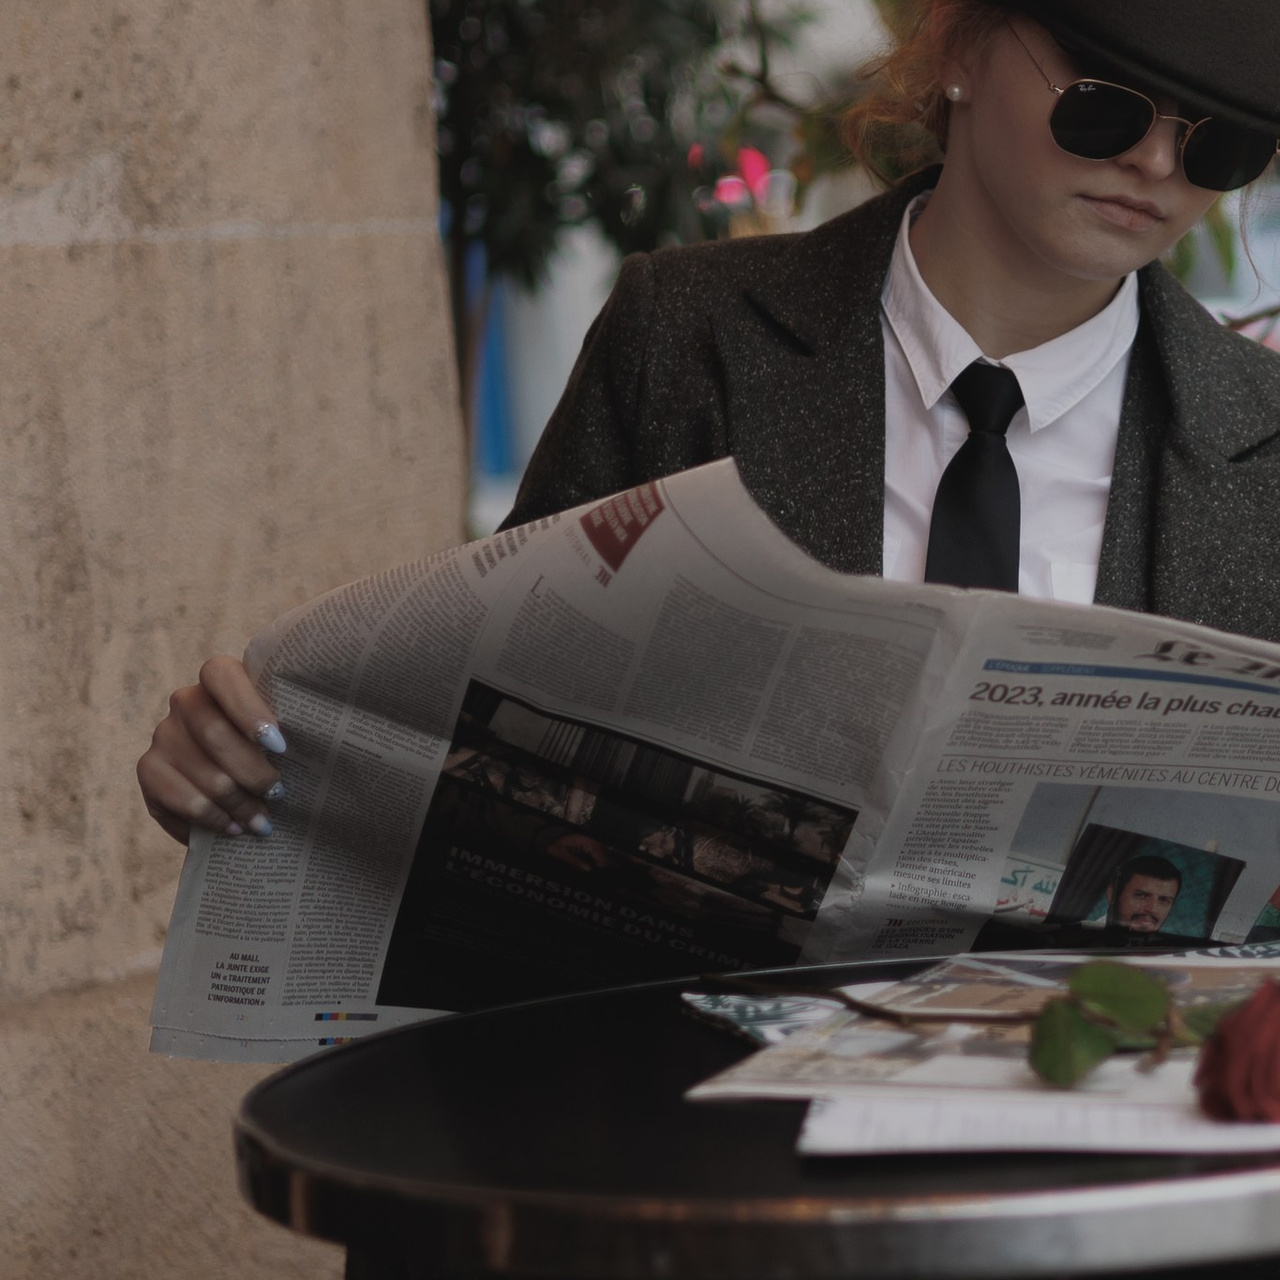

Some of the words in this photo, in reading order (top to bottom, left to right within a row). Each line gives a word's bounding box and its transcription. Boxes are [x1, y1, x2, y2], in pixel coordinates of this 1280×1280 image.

[1133, 639, 1216, 664] Le
[969, 681, 1044, 708] 2023,
[1049, 689, 1132, 710] année
[1136, 692, 1161, 711] la
[1163, 694, 1224, 716] plus
[937, 759, 968, 774] LES
[971, 760, 1076, 778] HOUTHISTES
[1079, 762, 1167, 786] YÉMÉNITES
[1172, 771, 1195, 787] AU
[1196, 772, 1260, 793] CENTRE
[894, 870, 926, 881] mesure
[927, 876, 941, 884] ses
[942, 876, 971, 888] limites
[896, 861, 928, 872] l'armée
[929, 865, 976, 879] américaine
[450, 846, 614, 910] IMMERSION
[619, 907, 695, 937] DANS
[446, 860, 616, 928] L'ÉCONOMIE
[623, 922, 662, 942] DU
[889, 891, 908, 901] lade
[908, 894, 919, 903] en
[921, 896, 939, 906] mer
[941, 899, 967, 911] Rouge
[229, 952, 239, 960] AU
[241, 954, 260, 963] MALI,
[215, 961, 224, 969] LA
[226, 963, 248, 972] JUNTE
[250, 965, 270, 974] EXIGE
[210, 972, 221, 980] UN
[228, 974, 271, 985] TRAITEMENT
[210, 982, 255, 996] PATRIOTIQUE
[256, 987, 266, 995] DE
[208, 993, 261, 1006] L'INFORMATION
